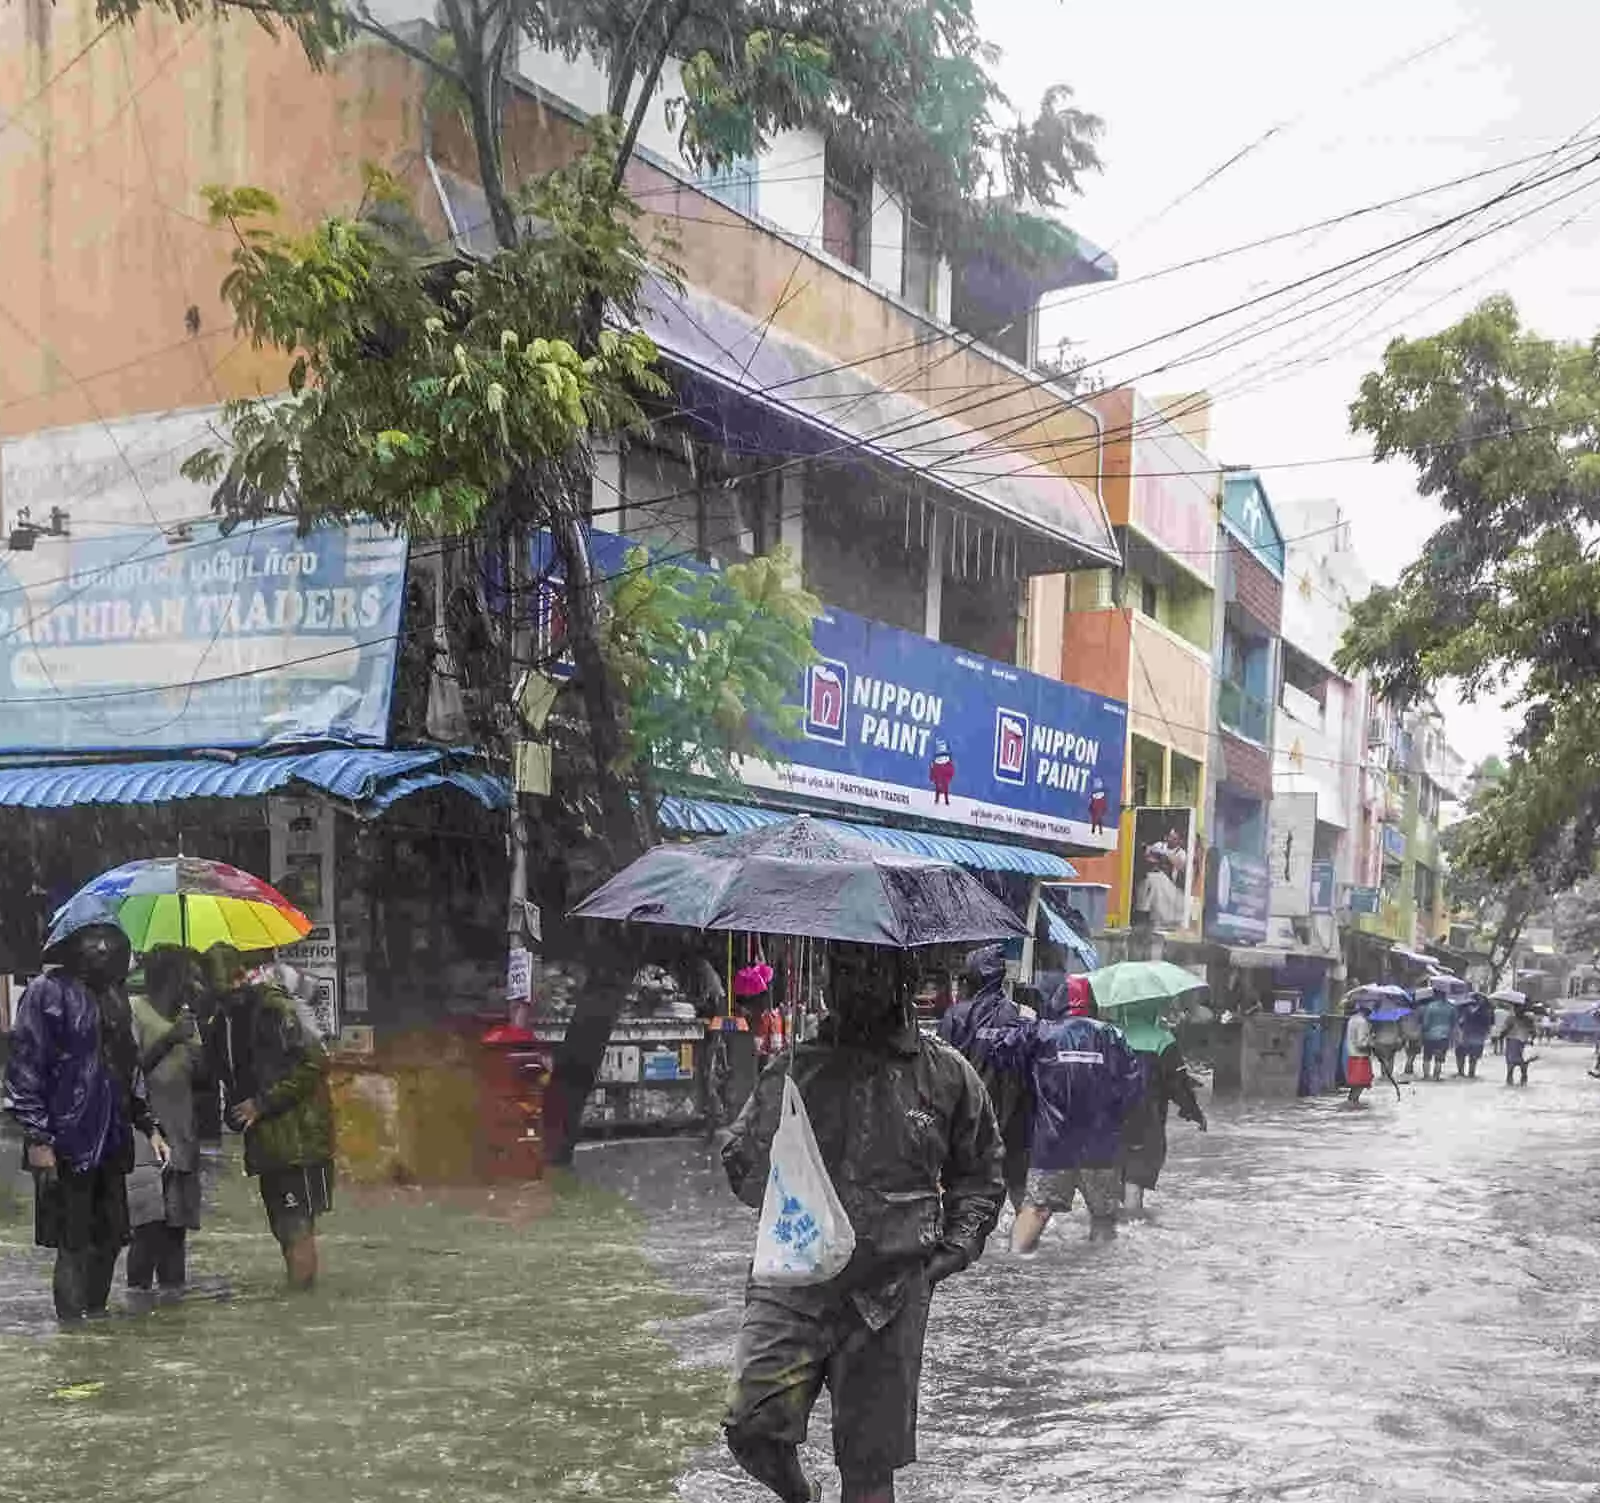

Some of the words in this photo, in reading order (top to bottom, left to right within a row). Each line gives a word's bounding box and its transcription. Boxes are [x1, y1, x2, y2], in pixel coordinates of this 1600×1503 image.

[197, 585, 383, 633] TRADERS
[852, 675, 944, 726] NIPPON
[860, 713, 932, 759] PAINT
[1031, 724, 1100, 766] NIPPON
[1036, 758, 1091, 794] PAINT
